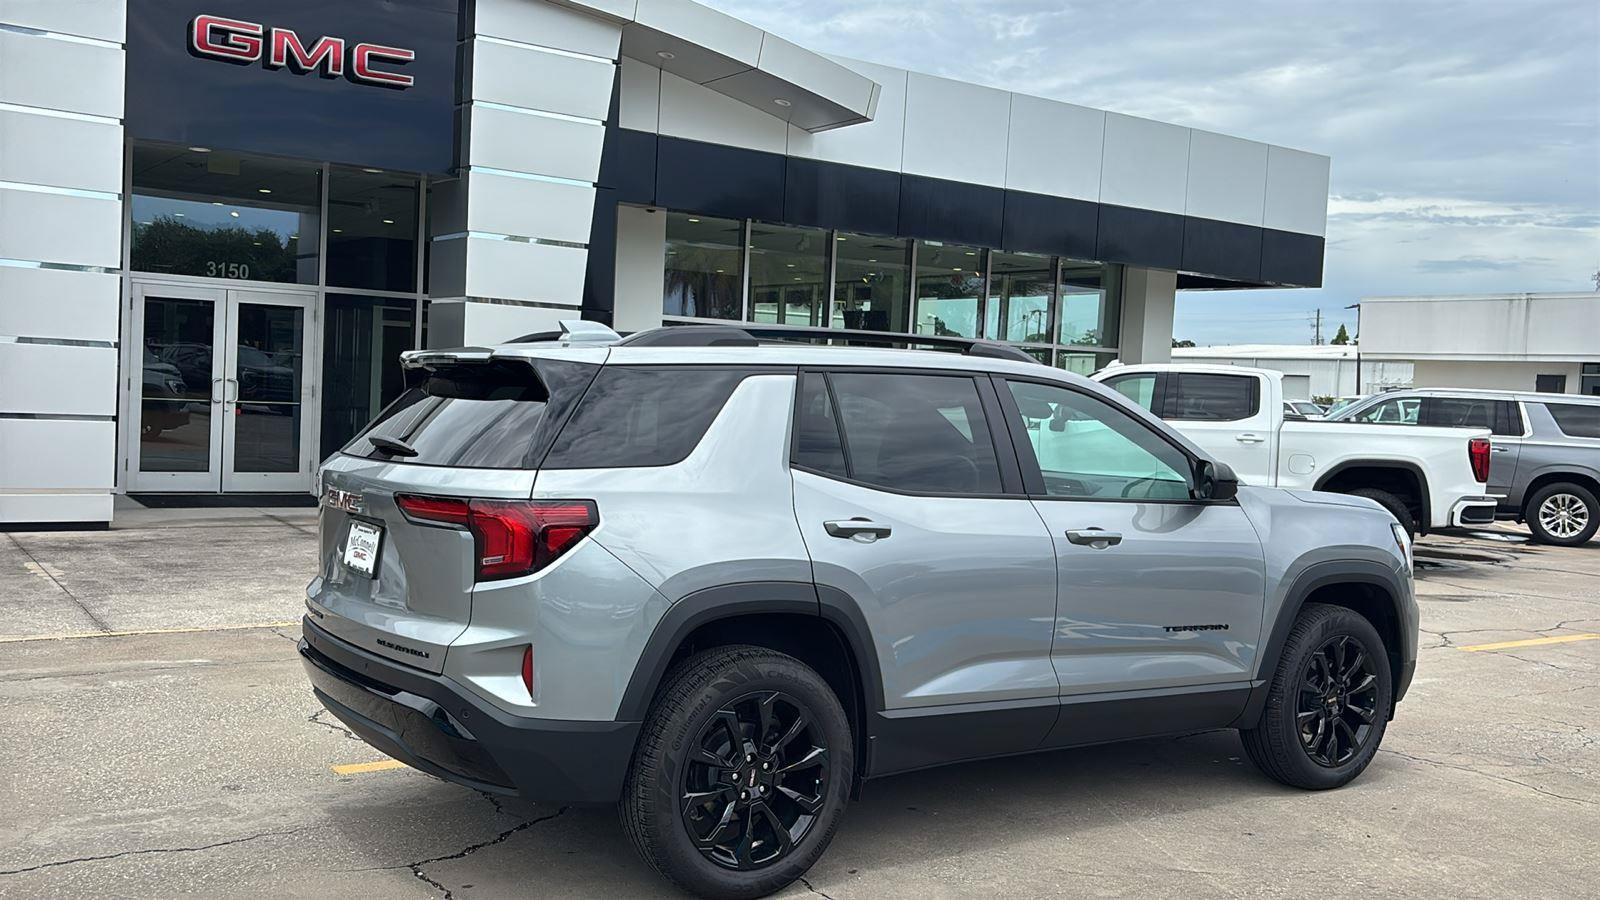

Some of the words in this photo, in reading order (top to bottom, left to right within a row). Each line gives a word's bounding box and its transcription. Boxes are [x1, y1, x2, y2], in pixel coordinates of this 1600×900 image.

[192, 14, 415, 87] GMC
[206, 260, 250, 279] 3150
[328, 489, 362, 512] GMC
[353, 550, 367, 561] GMC
[1162, 623, 1229, 632] TERRAIN
